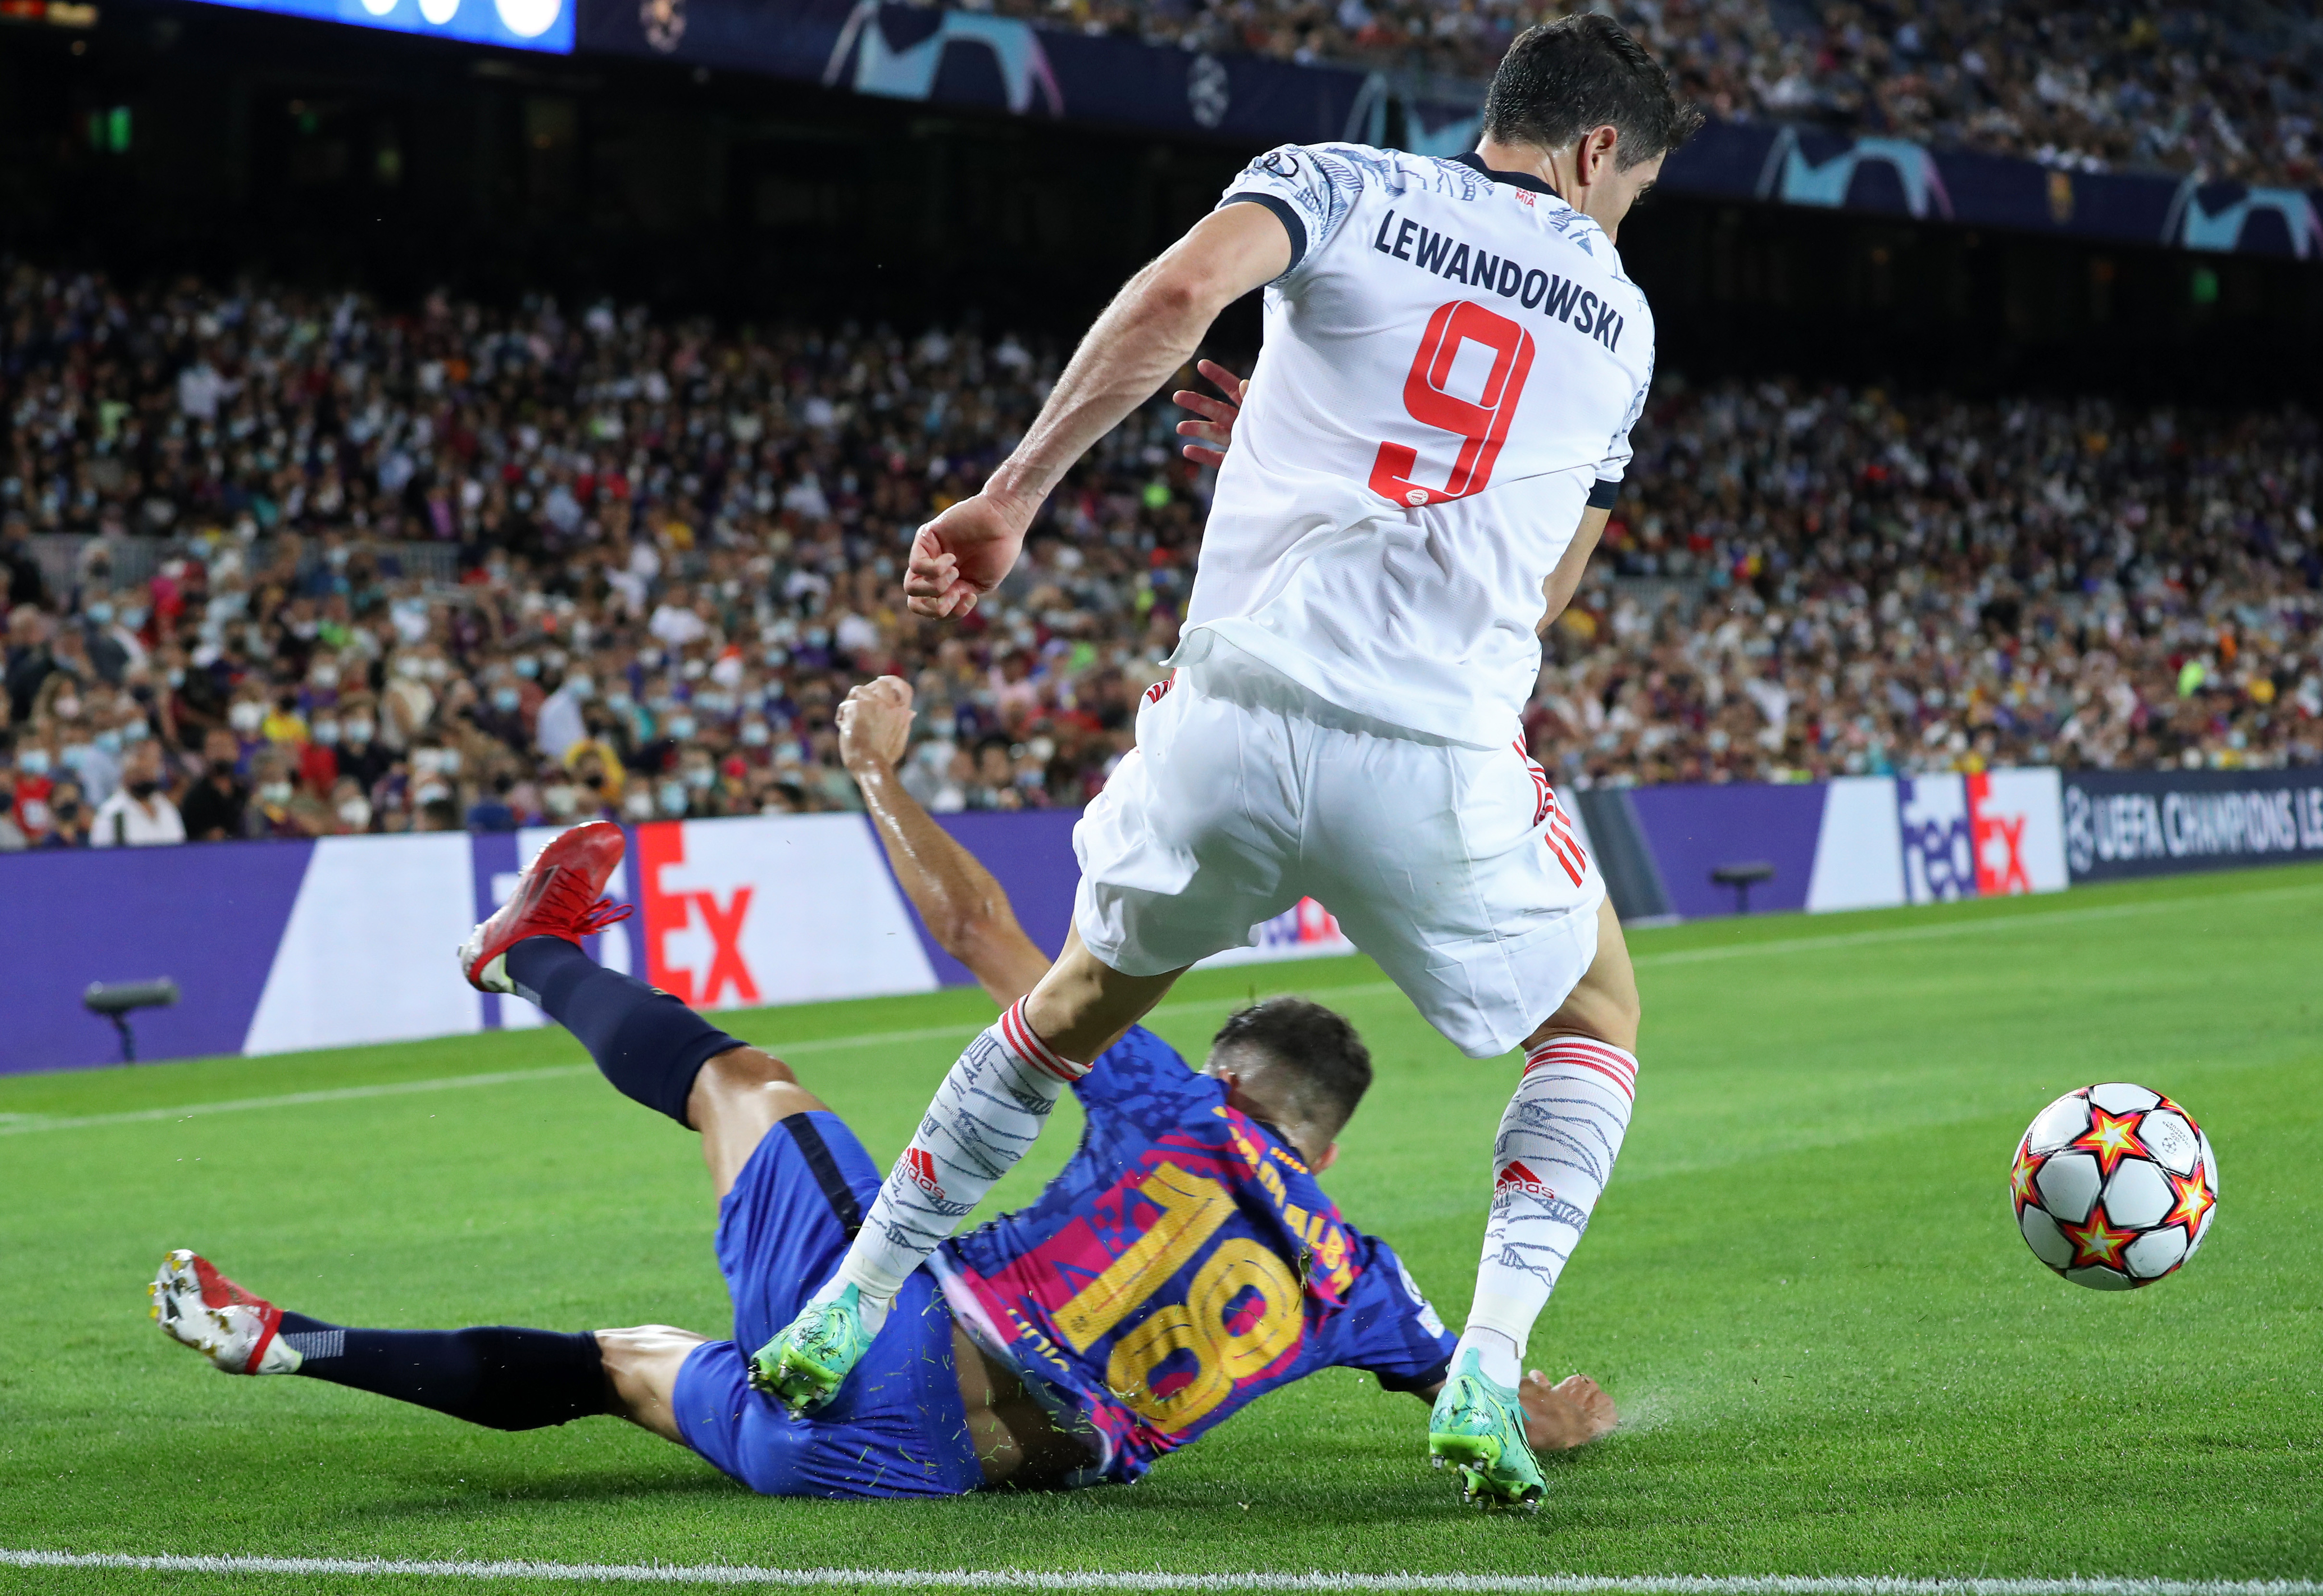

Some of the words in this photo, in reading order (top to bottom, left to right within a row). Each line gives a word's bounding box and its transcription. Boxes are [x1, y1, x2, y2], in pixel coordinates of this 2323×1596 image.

[1515, 192, 1534, 207] MIA
[1374, 209, 1624, 353] LEWANDOWSKI
[1368, 299, 1536, 508] 9
[1896, 771, 2032, 904] FedEx
[2092, 793, 2166, 861] UEFA
[2163, 789, 2297, 858] CHAMPIONS
[472, 820, 762, 1031] FdEx
[901, 1150, 946, 1199] didas
[2162, 1121, 2191, 1148] CHAMPIONS
[2169, 1122, 2188, 1141] LEAGUE
[1051, 1160, 1304, 1434] 18
